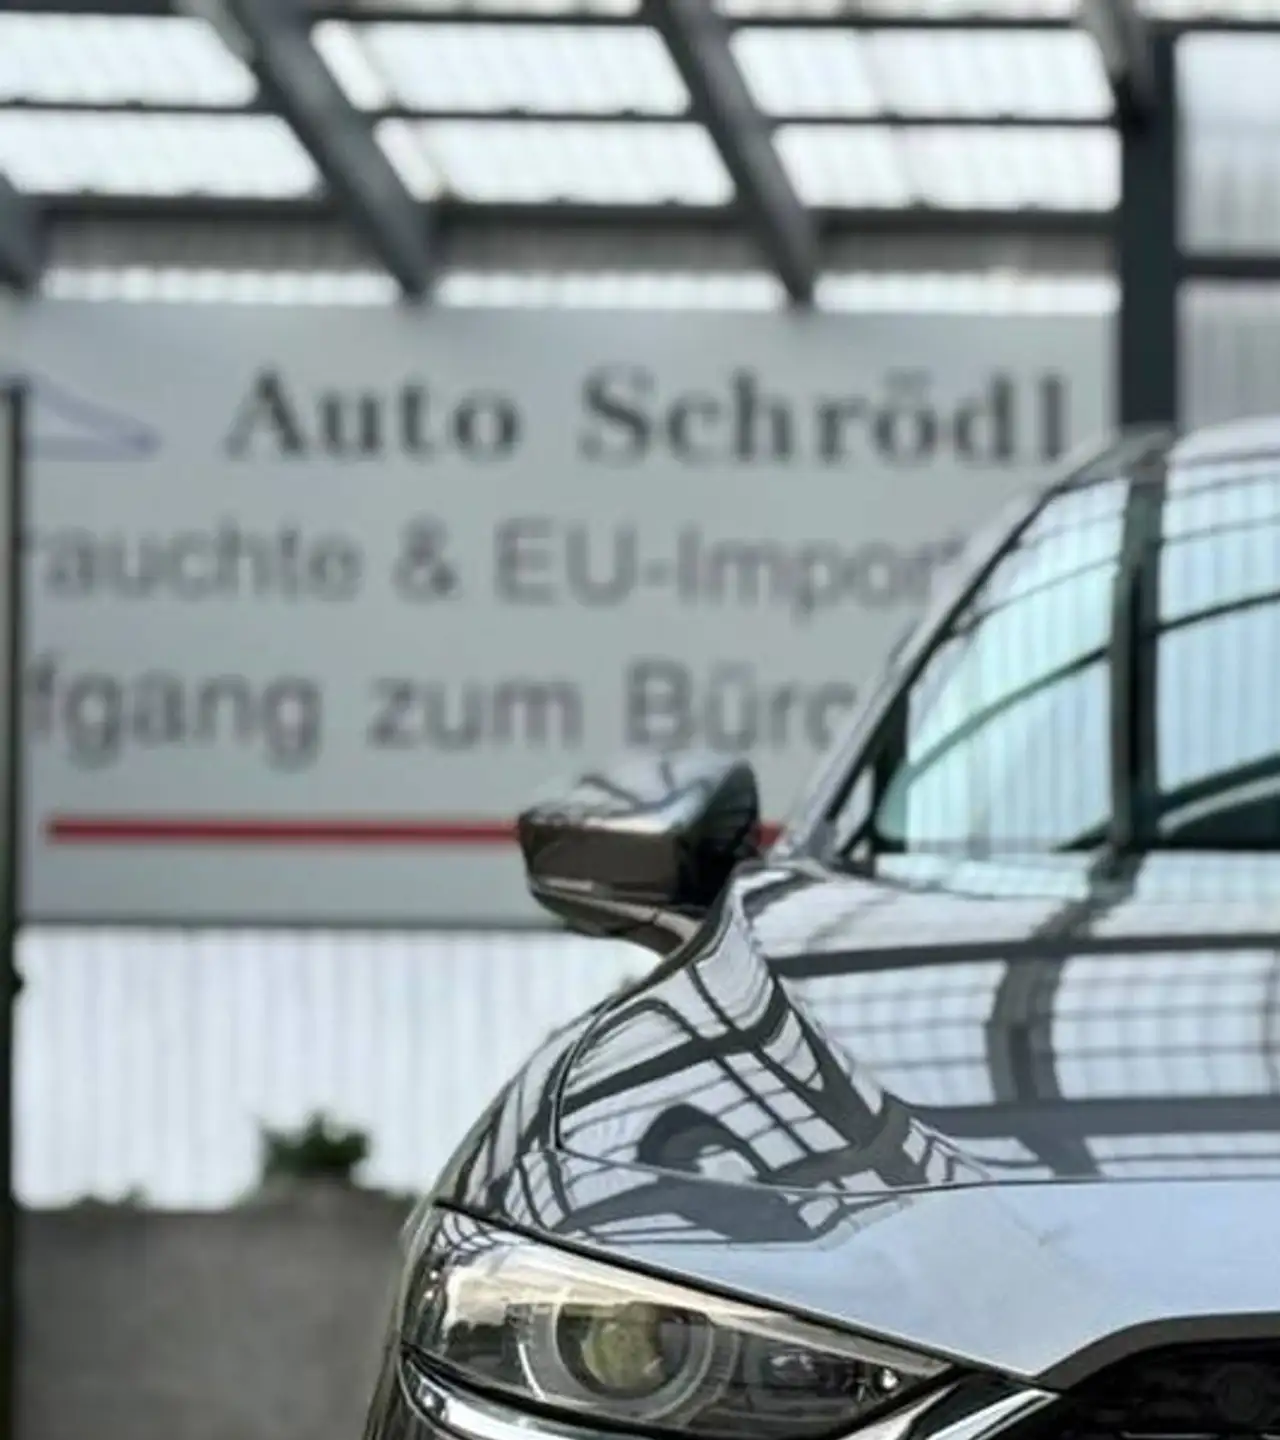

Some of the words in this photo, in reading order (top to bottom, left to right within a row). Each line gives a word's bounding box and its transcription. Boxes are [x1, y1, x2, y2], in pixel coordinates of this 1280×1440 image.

[224, 366, 524, 464] Auto
[577, 366, 1072, 470] Schrödl
[395, 514, 460, 600] &
[366, 674, 586, 752] zum
